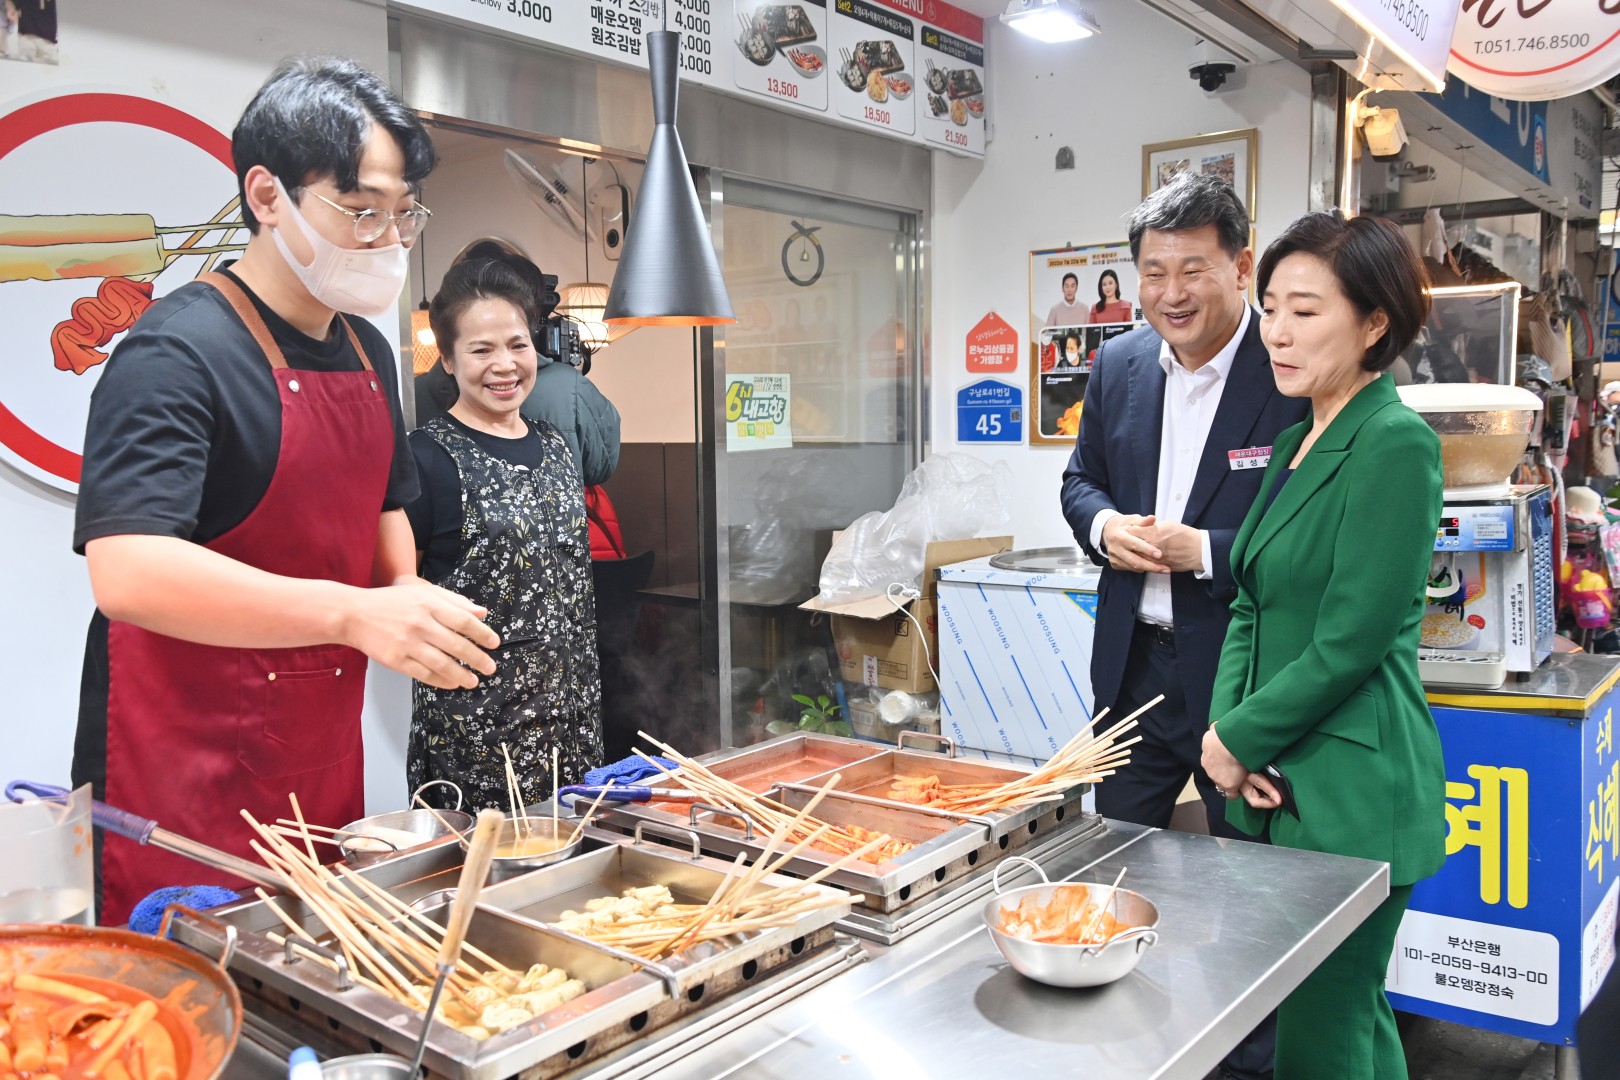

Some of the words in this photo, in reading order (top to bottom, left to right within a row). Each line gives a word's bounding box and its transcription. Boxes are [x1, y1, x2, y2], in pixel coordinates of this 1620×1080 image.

[507, 0, 551, 23] 3,000
[675, 11, 711, 35] 4,000
[590, 5, 642, 35] 매운오뎅
[681, 31, 711, 55] ,000
[591, 26, 642, 56] 원조김밥
[1474, 33, 1590, 54] T.051.746.8500
[767, 77, 799, 98] 13,500
[864, 106, 891, 125] 18,500
[945, 129, 968, 147] 21,500
[969, 344, 1015, 355] 온누리상품권
[980, 355, 1003, 365] 가맹점
[968, 387, 1010, 397] 구남로41번길
[743, 394, 786, 424] 내고향
[975, 413, 1002, 435] 45
[940, 603, 963, 645] WOOSUNG
[987, 607, 1010, 650] WOOSUNG
[1036, 611, 1060, 655] WOOSUNG
[1596, 707, 1613, 766] 수제
[1585, 759, 1620, 884] 식혜
[1447, 935, 1501, 957] 부산은행
[1404, 946, 1549, 985] 101-2059-9413-00
[1434, 972, 1515, 1000] 불오뎅장정숙
